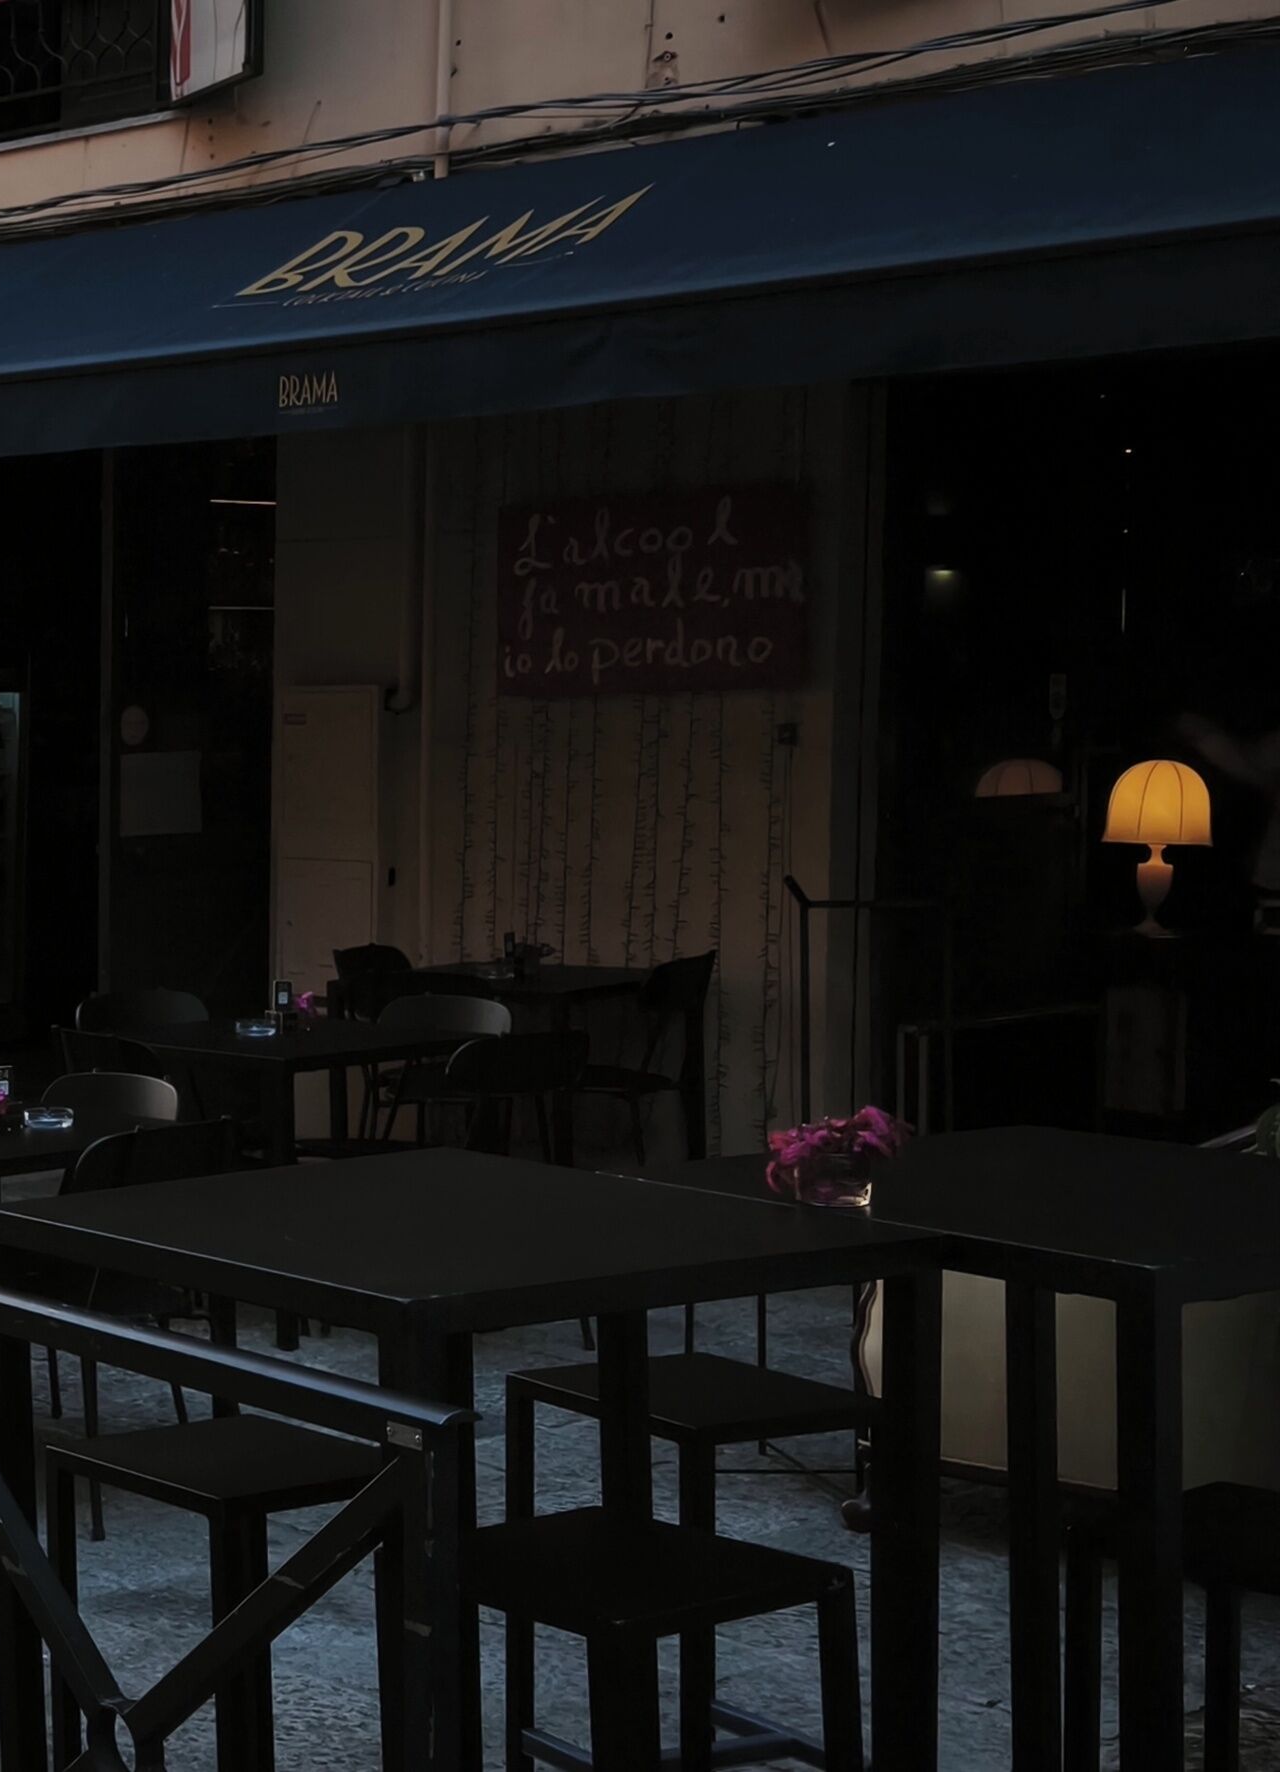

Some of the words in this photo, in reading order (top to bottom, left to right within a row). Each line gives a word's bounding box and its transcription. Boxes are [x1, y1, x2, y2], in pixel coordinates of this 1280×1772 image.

[235, 183, 656, 296] BRAMA
[278, 369, 338, 408] BRAMA
[504, 645, 532, 678] io
[543, 625, 579, 675] lo
[588, 616, 774, 686] perdono
